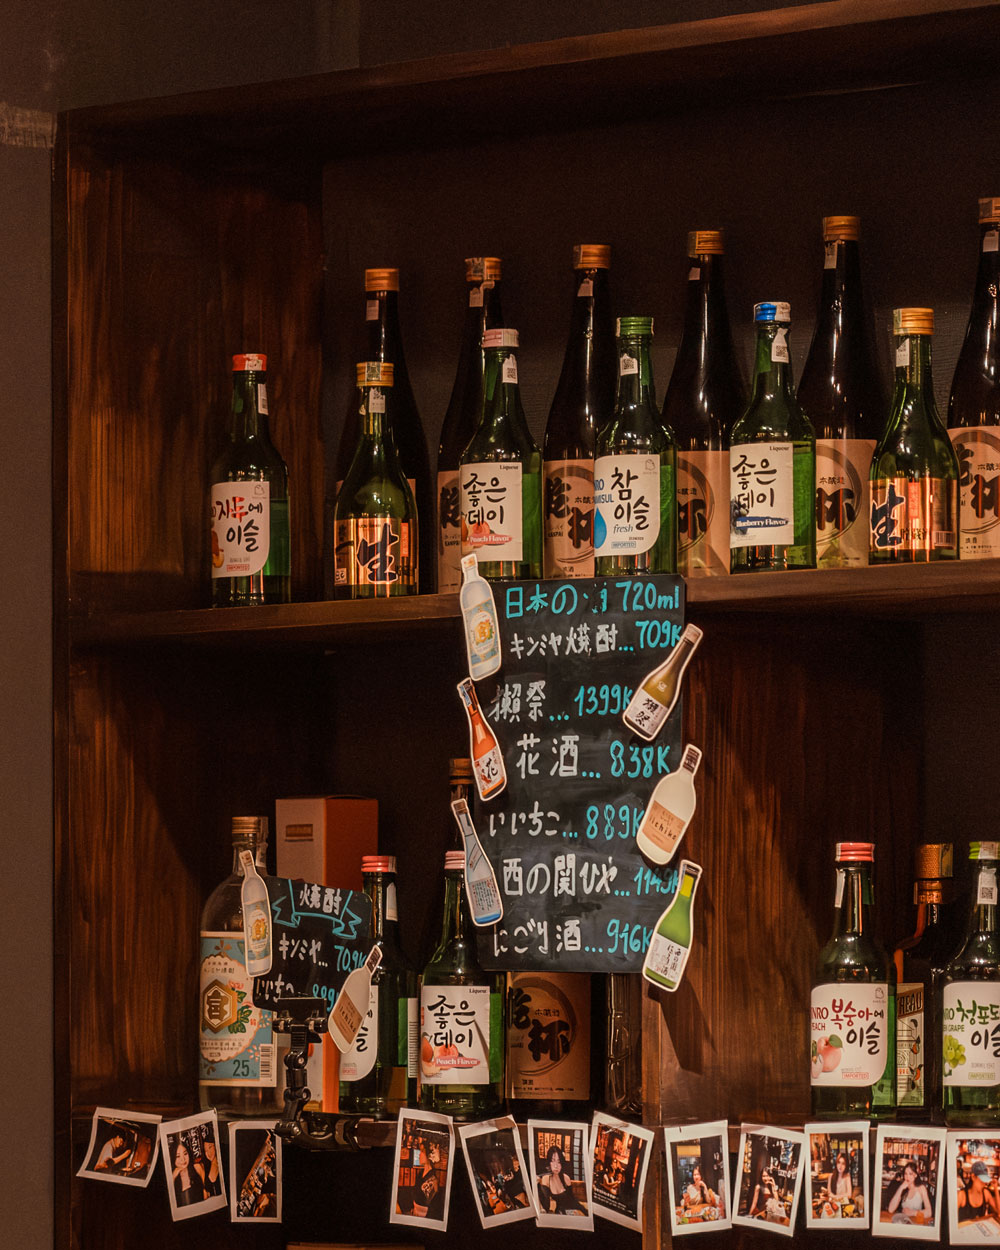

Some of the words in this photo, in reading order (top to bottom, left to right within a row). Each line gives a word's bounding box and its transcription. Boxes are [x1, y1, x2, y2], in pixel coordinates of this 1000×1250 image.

[611, 466, 639, 501] 참
[732, 455, 777, 490] 좋은
[463, 473, 507, 507] 좋은
[468, 505, 505, 527] 데이
[613, 524, 634, 534] fresh
[614, 495, 650, 530] 이슬
[226, 519, 260, 552] 이슬
[616, 580, 680, 611] 720ml
[635, 620, 682, 649] 709K
[574, 684, 634, 717] 1399K
[609, 739, 671, 779] 838K
[586, 804, 646, 840] 889K
[606, 918, 653, 955] 916K
[427, 995, 476, 1029] 좋은
[830, 998, 884, 1031] 복숭아에
[433, 1029, 473, 1048] 데이
[846, 1021, 881, 1055] 이슬
[232, 1059, 250, 1077] 25
